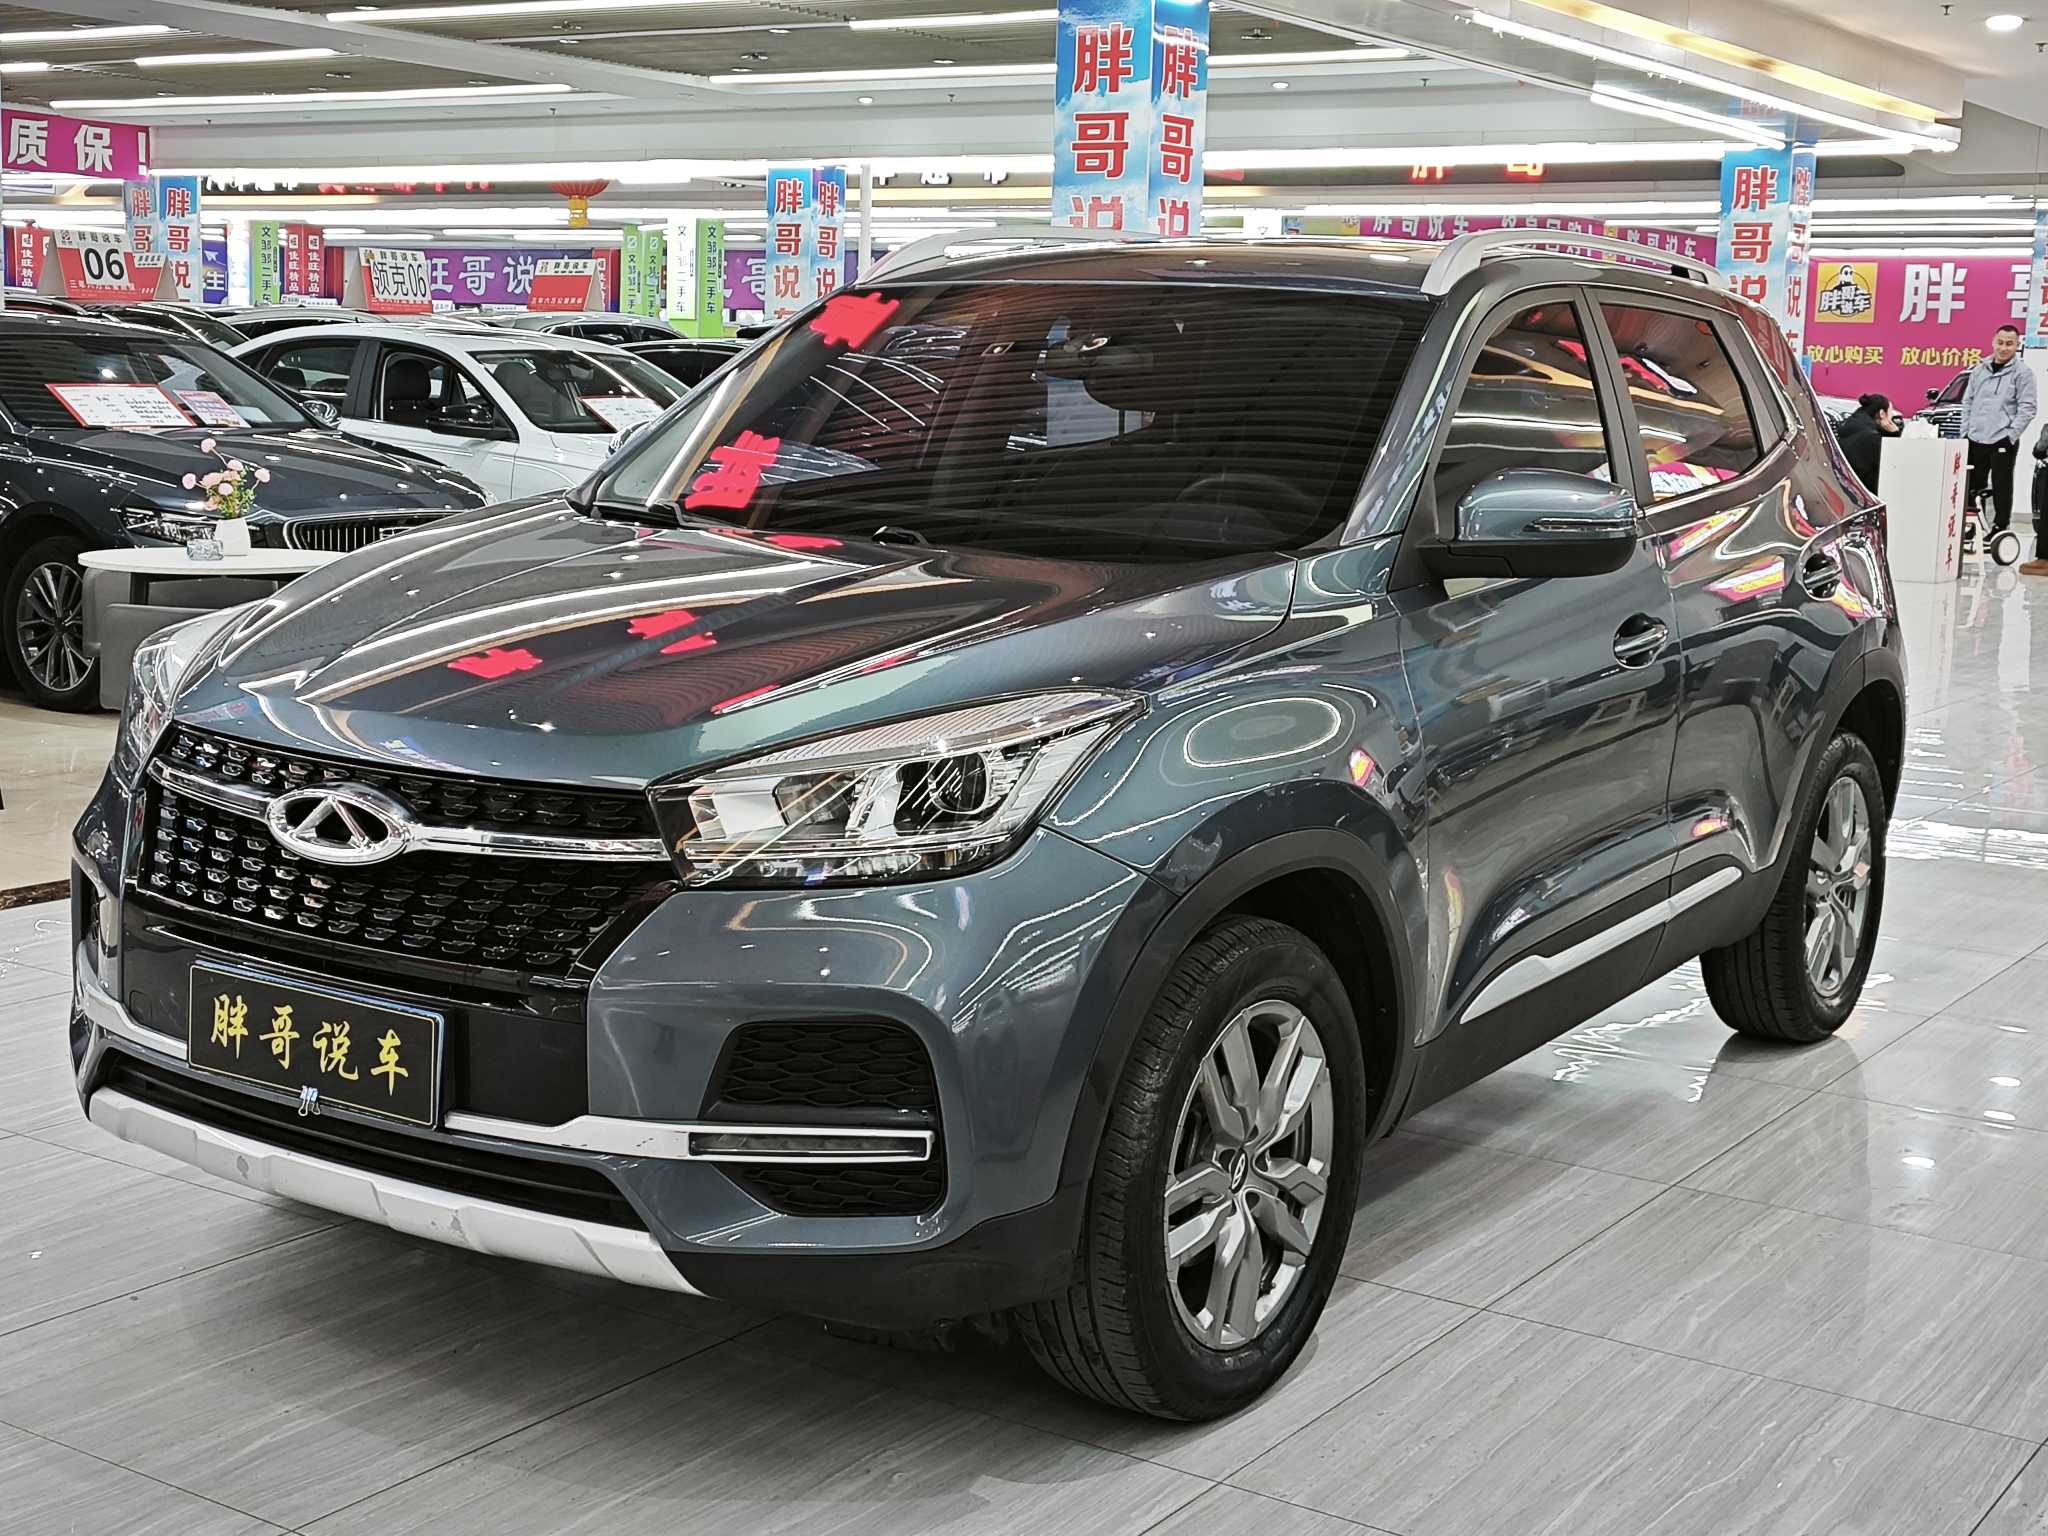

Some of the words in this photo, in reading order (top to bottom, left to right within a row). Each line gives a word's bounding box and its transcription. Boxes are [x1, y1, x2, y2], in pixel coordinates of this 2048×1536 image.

[83, 247, 125, 280] 06
[167, 189, 192, 302] 胖哥说
[373, 261, 427, 298] 领克06
[1806, 344, 1884, 366] 放心购买
[1900, 346, 1983, 367] 放心价格
[210, 993, 409, 1096] 胖哥说车
